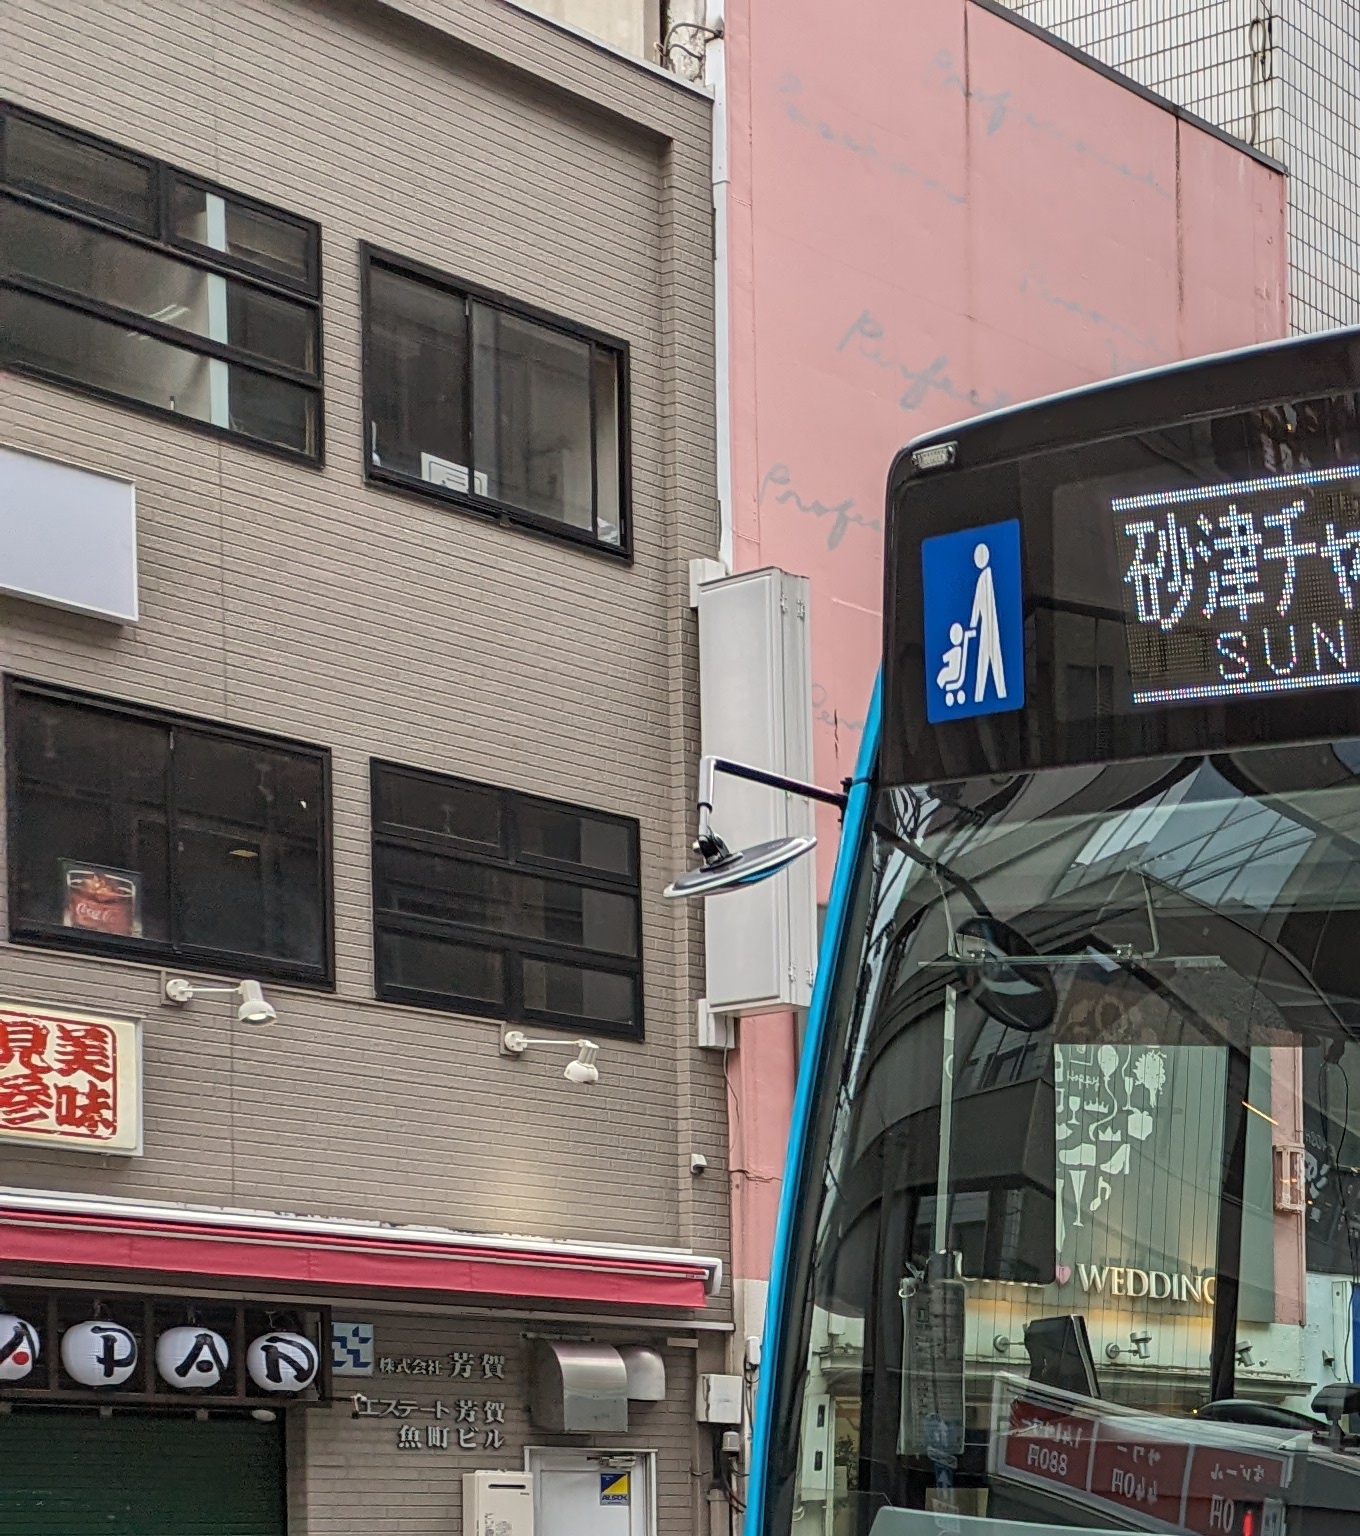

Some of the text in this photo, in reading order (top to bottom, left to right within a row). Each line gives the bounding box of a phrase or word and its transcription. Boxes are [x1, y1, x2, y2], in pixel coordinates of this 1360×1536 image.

[379, 1352, 505, 1379] 株式会社 芳賀
[359, 1399, 505, 1424] エステート 芳賀
[398, 1425, 504, 1449] 魚町ビル
